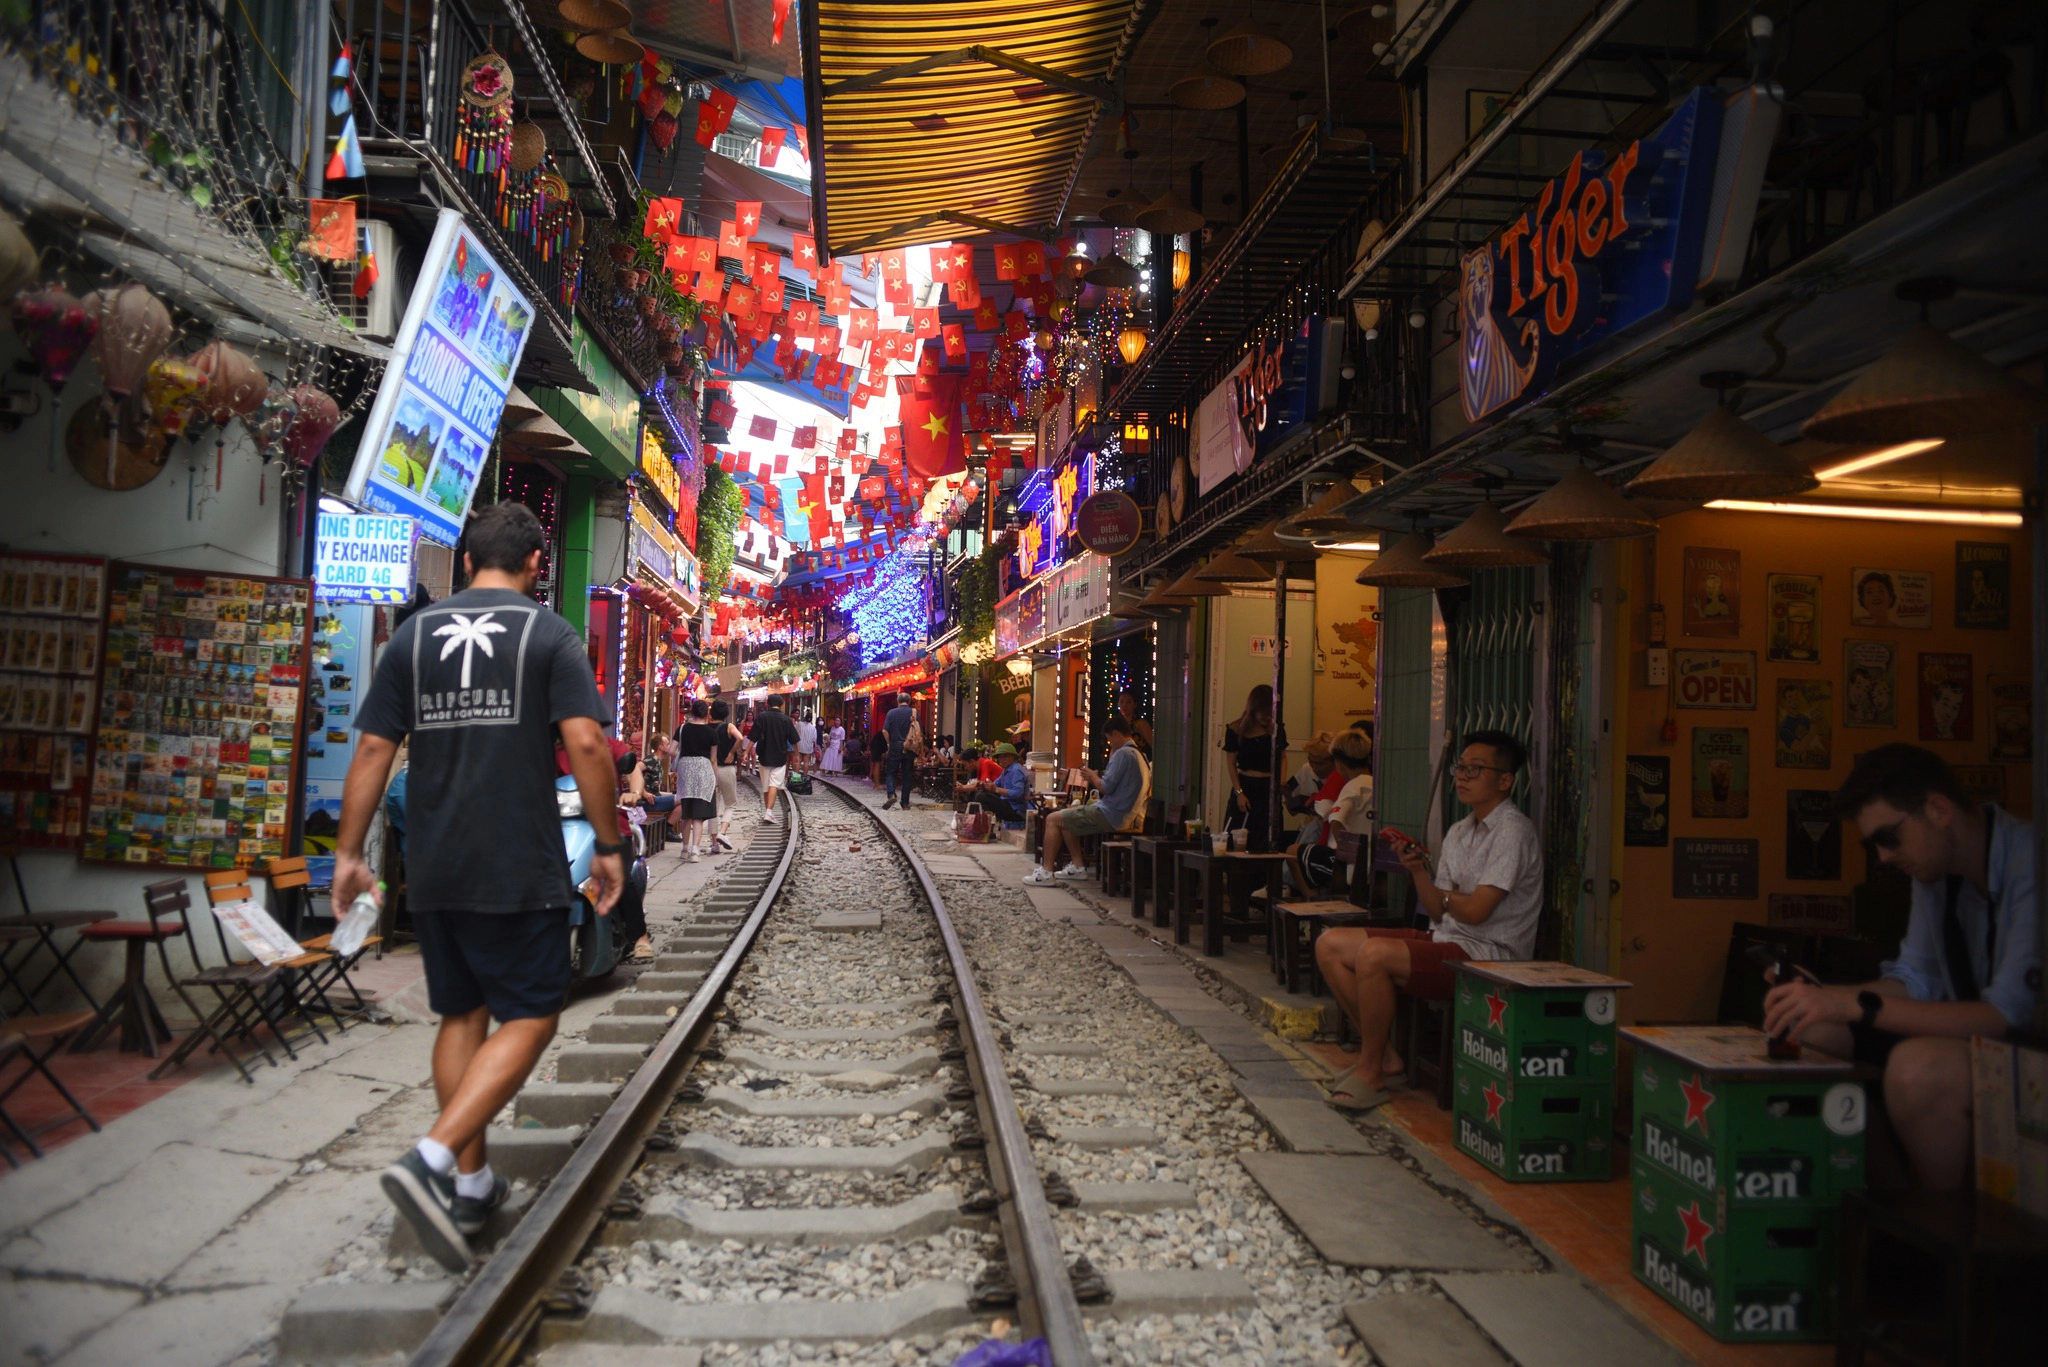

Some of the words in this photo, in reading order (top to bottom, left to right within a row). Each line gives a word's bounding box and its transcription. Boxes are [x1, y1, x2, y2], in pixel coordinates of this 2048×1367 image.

[1500, 139, 1640, 336] Tiger
[408, 328, 471, 411] BOOKING
[461, 373, 504, 438] OFFICE
[1238, 336, 1285, 432] Tiger
[318, 516, 350, 538] ING
[355, 518, 409, 540] OFFICE
[332, 541, 408, 564] EXCHANGE
[325, 565, 367, 584] CARD
[371, 567, 392, 585] 4G
[1773, 582, 1817, 598] TEQUILA
[1332, 670, 1361, 679] Thailand
[1000, 674, 1031, 696] BEER
[1682, 675, 1752, 704] OPEN
[423, 709, 451, 721] MADE
[472, 707, 511, 718] WAVES
[1709, 732, 1734, 744] ICED
[1699, 743, 1745, 756] COFFEE
[1686, 843, 1749, 855] HAPPINESS
[1692, 873, 1739, 887] LIFE
[1597, 997, 1608, 1015] 3
[1840, 1095, 1855, 1123] 2
